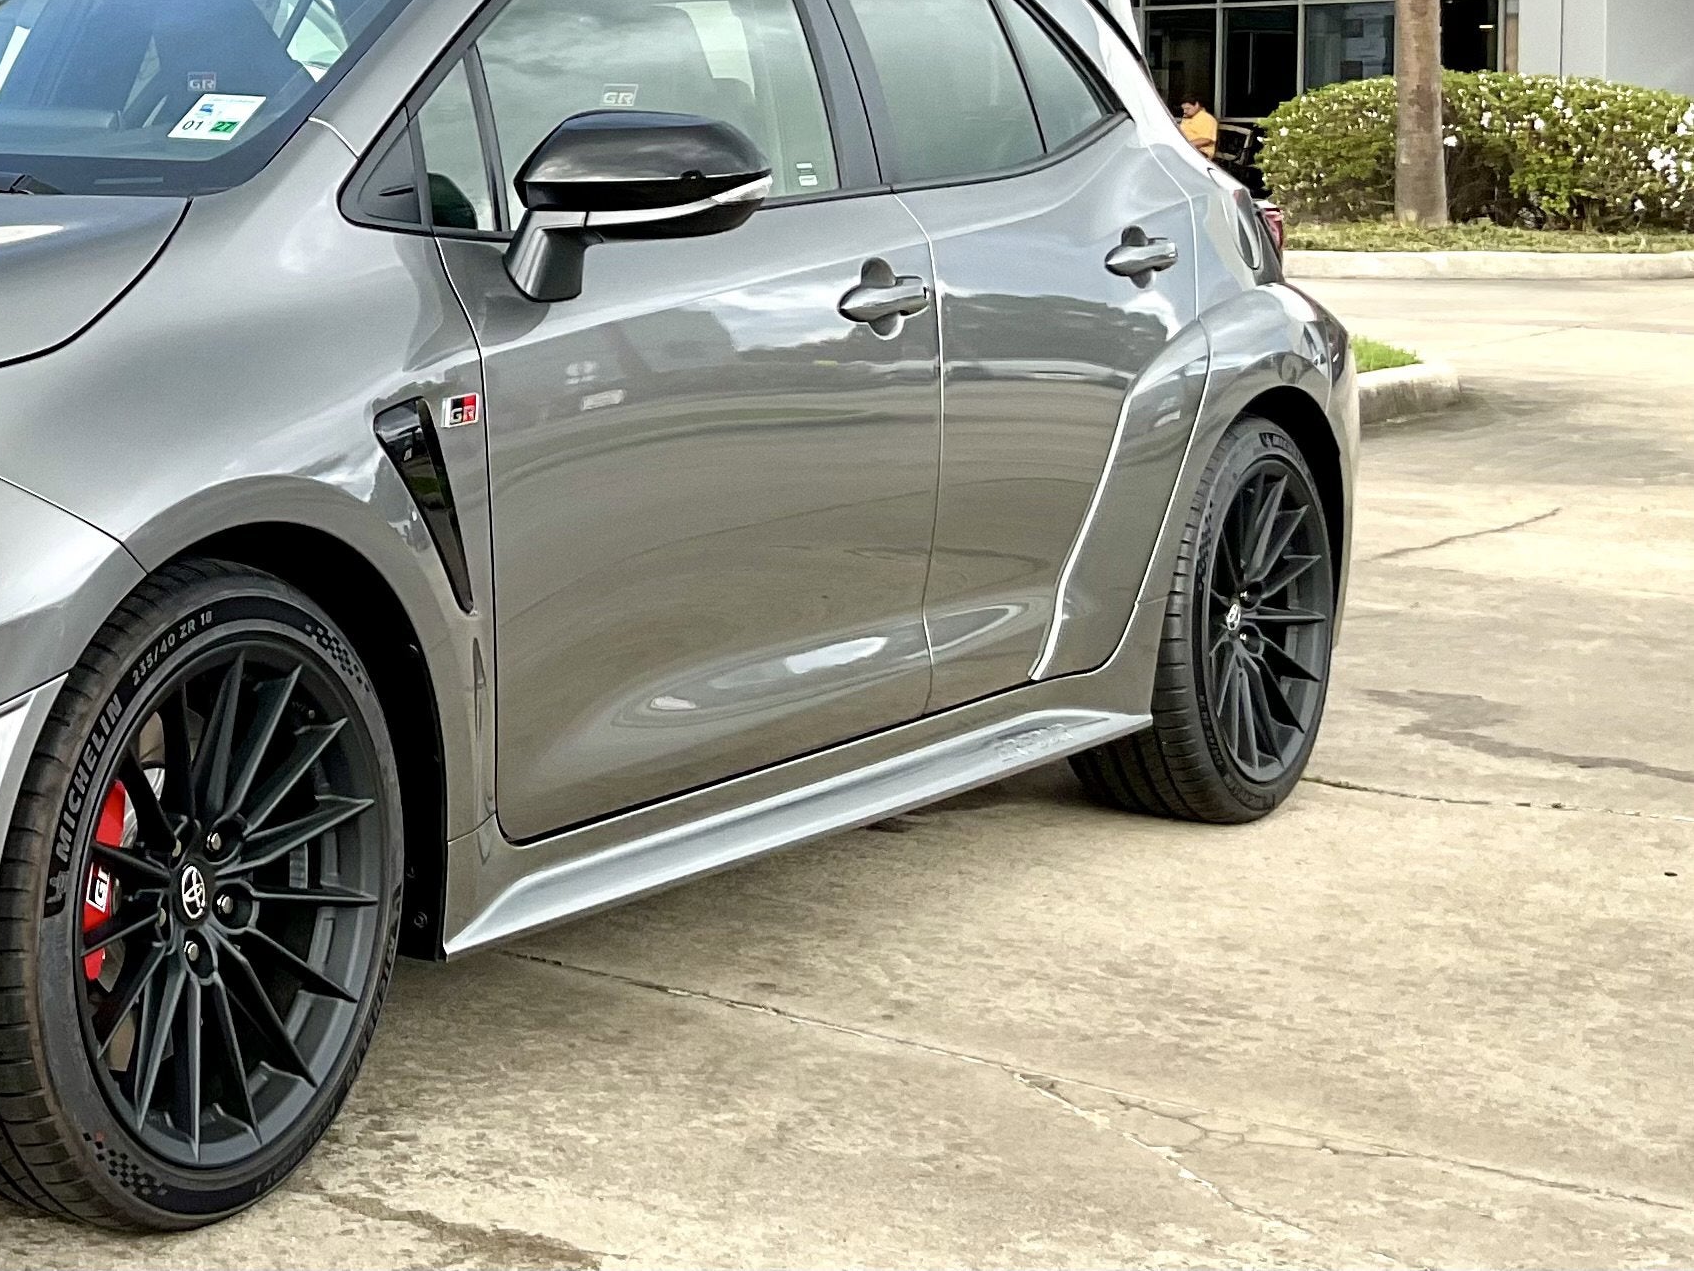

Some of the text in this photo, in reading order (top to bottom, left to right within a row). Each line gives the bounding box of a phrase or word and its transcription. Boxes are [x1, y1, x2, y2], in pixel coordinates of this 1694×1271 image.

[182, 120, 238, 132] 01 27
[450, 405, 475, 424] GR
[55, 693, 123, 863] MICHELIN
[132, 633, 176, 686] 235/40
[179, 619, 196, 639] ZR
